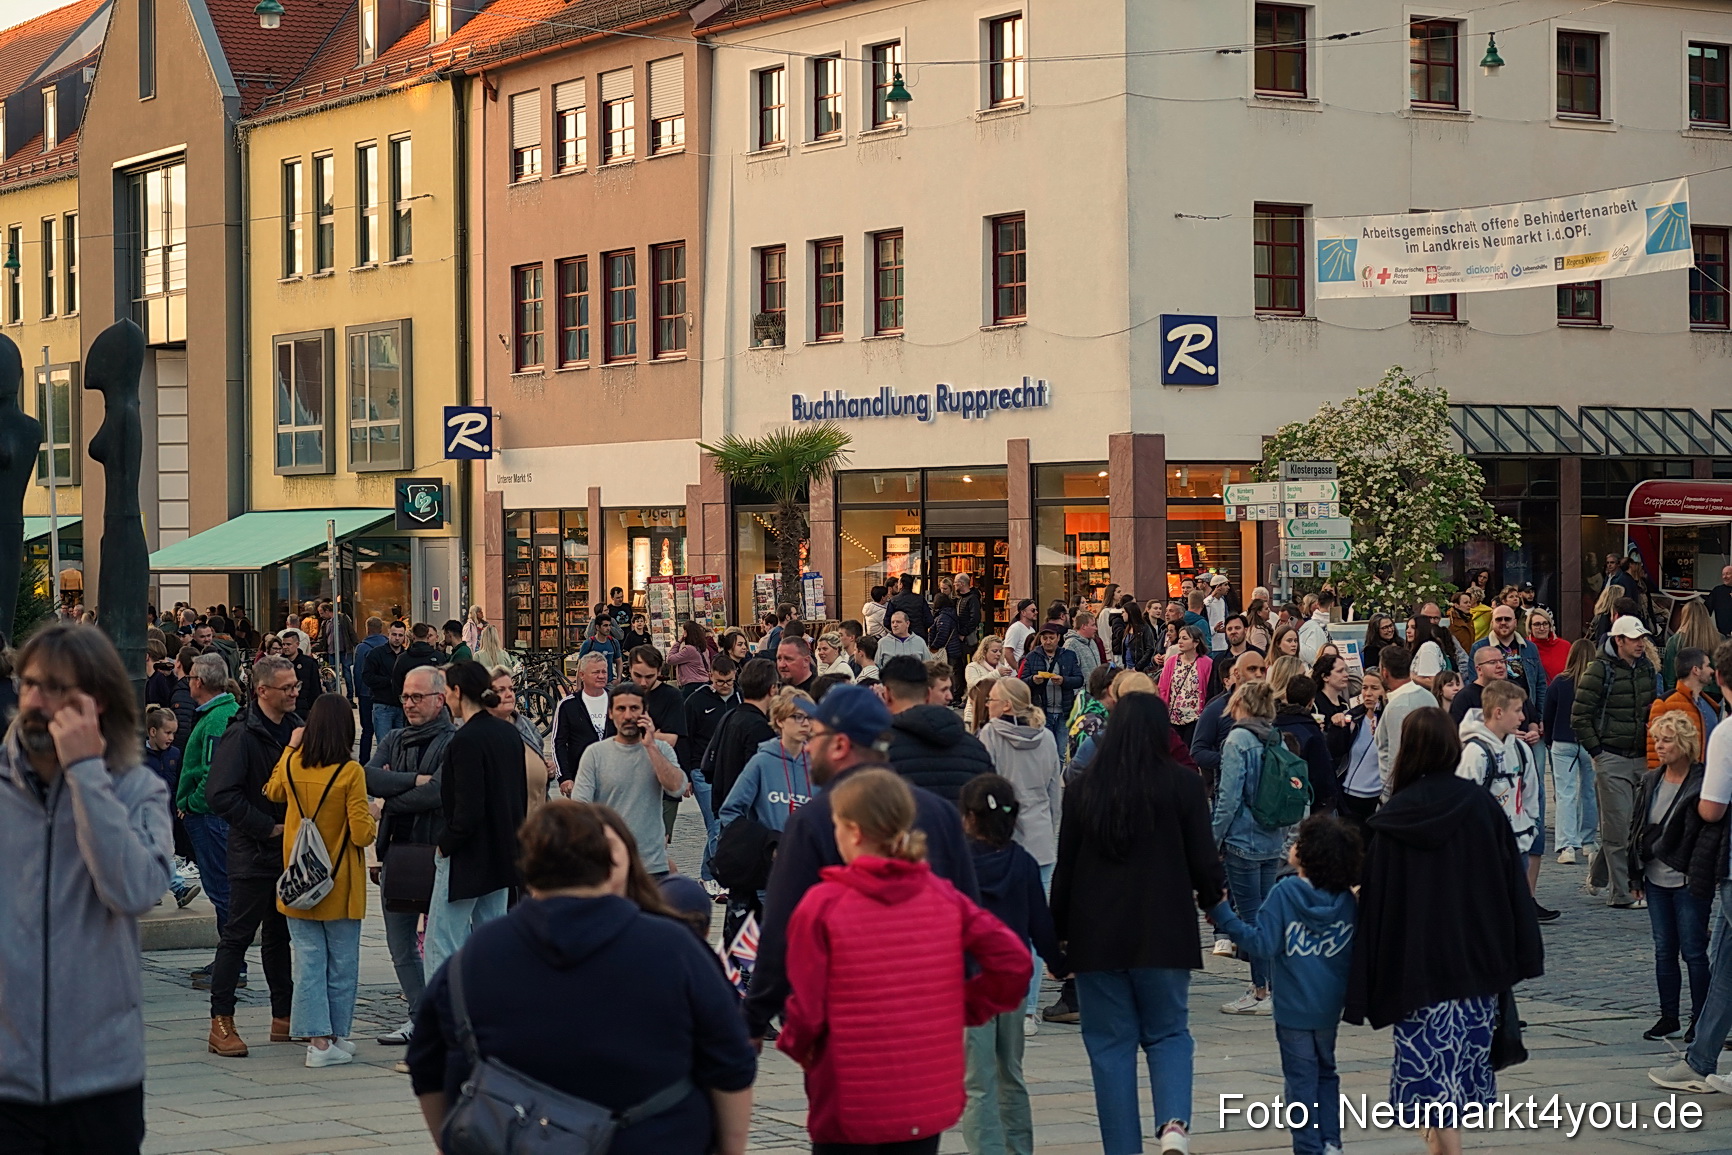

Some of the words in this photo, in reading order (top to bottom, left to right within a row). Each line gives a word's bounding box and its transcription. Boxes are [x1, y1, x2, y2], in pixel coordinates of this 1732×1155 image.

[1362, 220, 1477, 240] Arbeitsgemeinschaft
[1481, 217, 1519, 231] offene
[1524, 199, 1638, 226] Behindertenarbeit
[1405, 242, 1419, 253] im
[1423, 237, 1480, 253] Landkreis
[1483, 231, 1542, 248] Neumarkt
[1566, 257, 1584, 267] Regens
[1466, 264, 1500, 274] diakonie
[1523, 264, 1548, 272] Lebenshilfe
[1495, 270, 1509, 280] nah
[792, 386, 933, 422] Buchhandlung
[936, 376, 1048, 419] Rupprecht
[1290, 463, 1333, 477] Klostergasse
[497, 475, 512, 484] Unterer
[513, 474, 526, 483] Markt
[527, 473, 532, 482] 15
[1643, 497, 1683, 509] Creppresso
